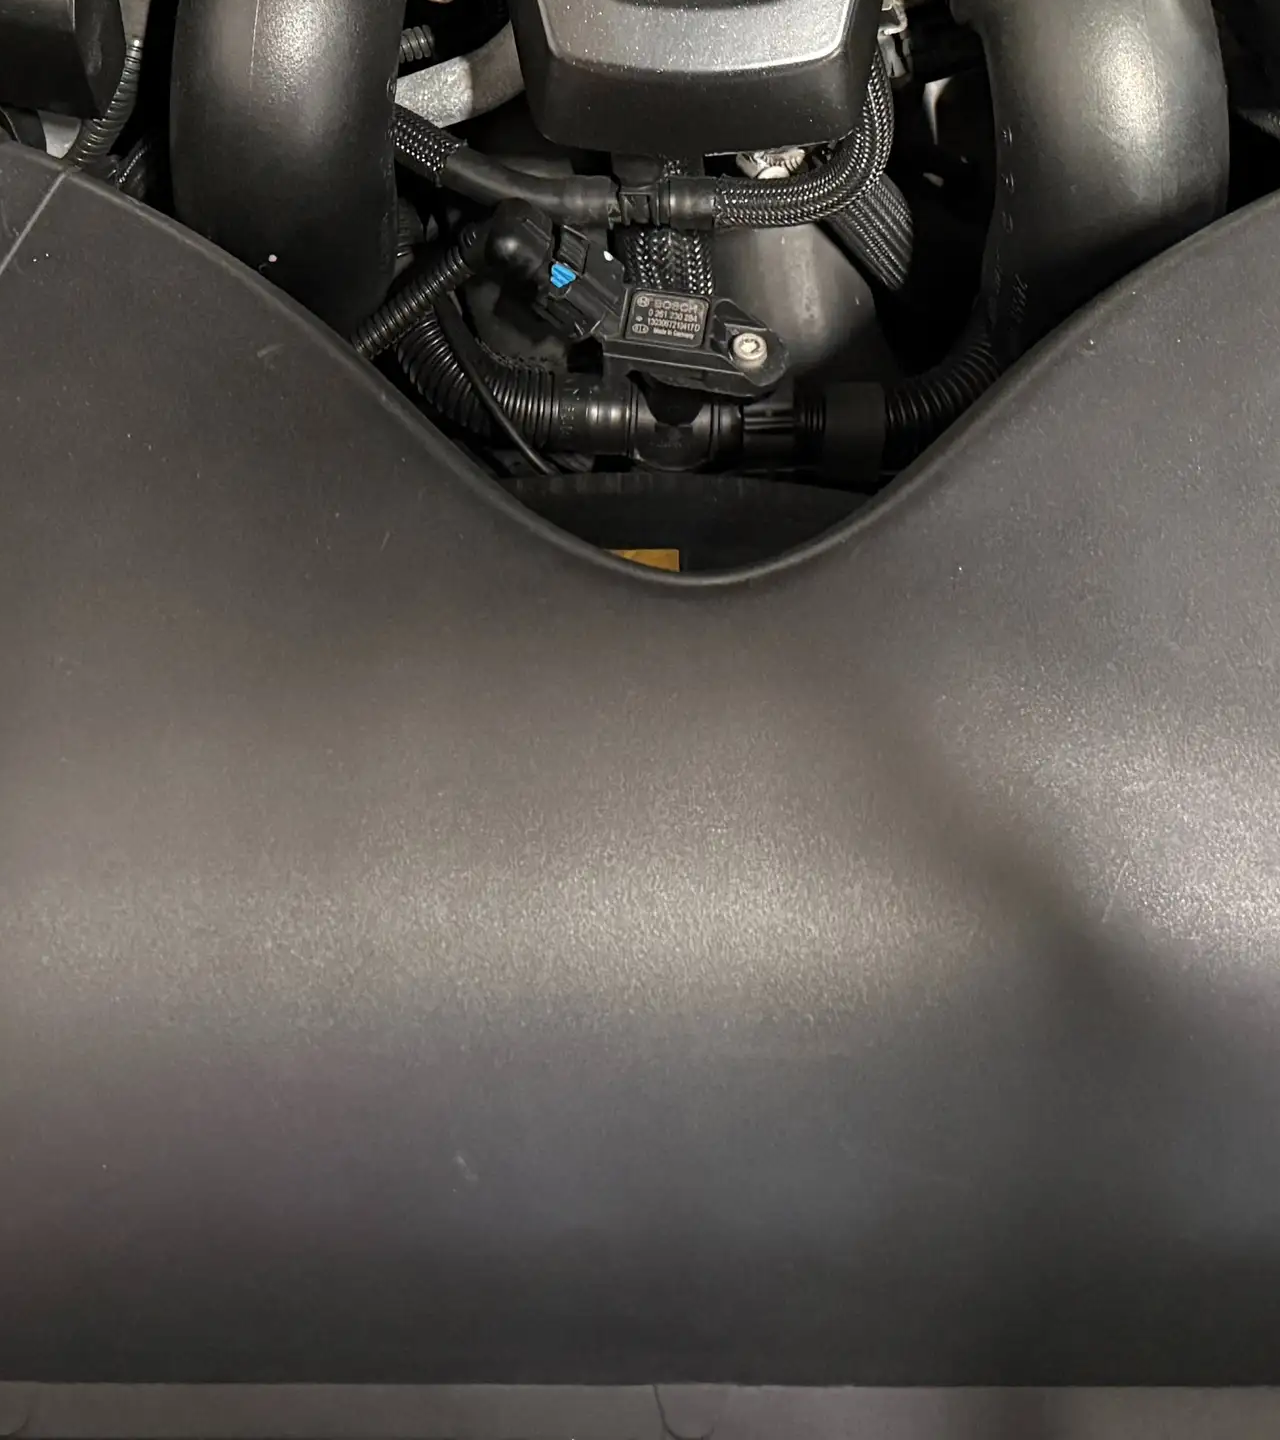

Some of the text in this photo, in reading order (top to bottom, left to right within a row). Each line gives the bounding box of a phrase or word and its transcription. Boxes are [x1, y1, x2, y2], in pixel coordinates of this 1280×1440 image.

[654, 299, 698, 313] BOSCH
[648, 308, 654, 317] 0
[672, 329, 695, 340] Germany
